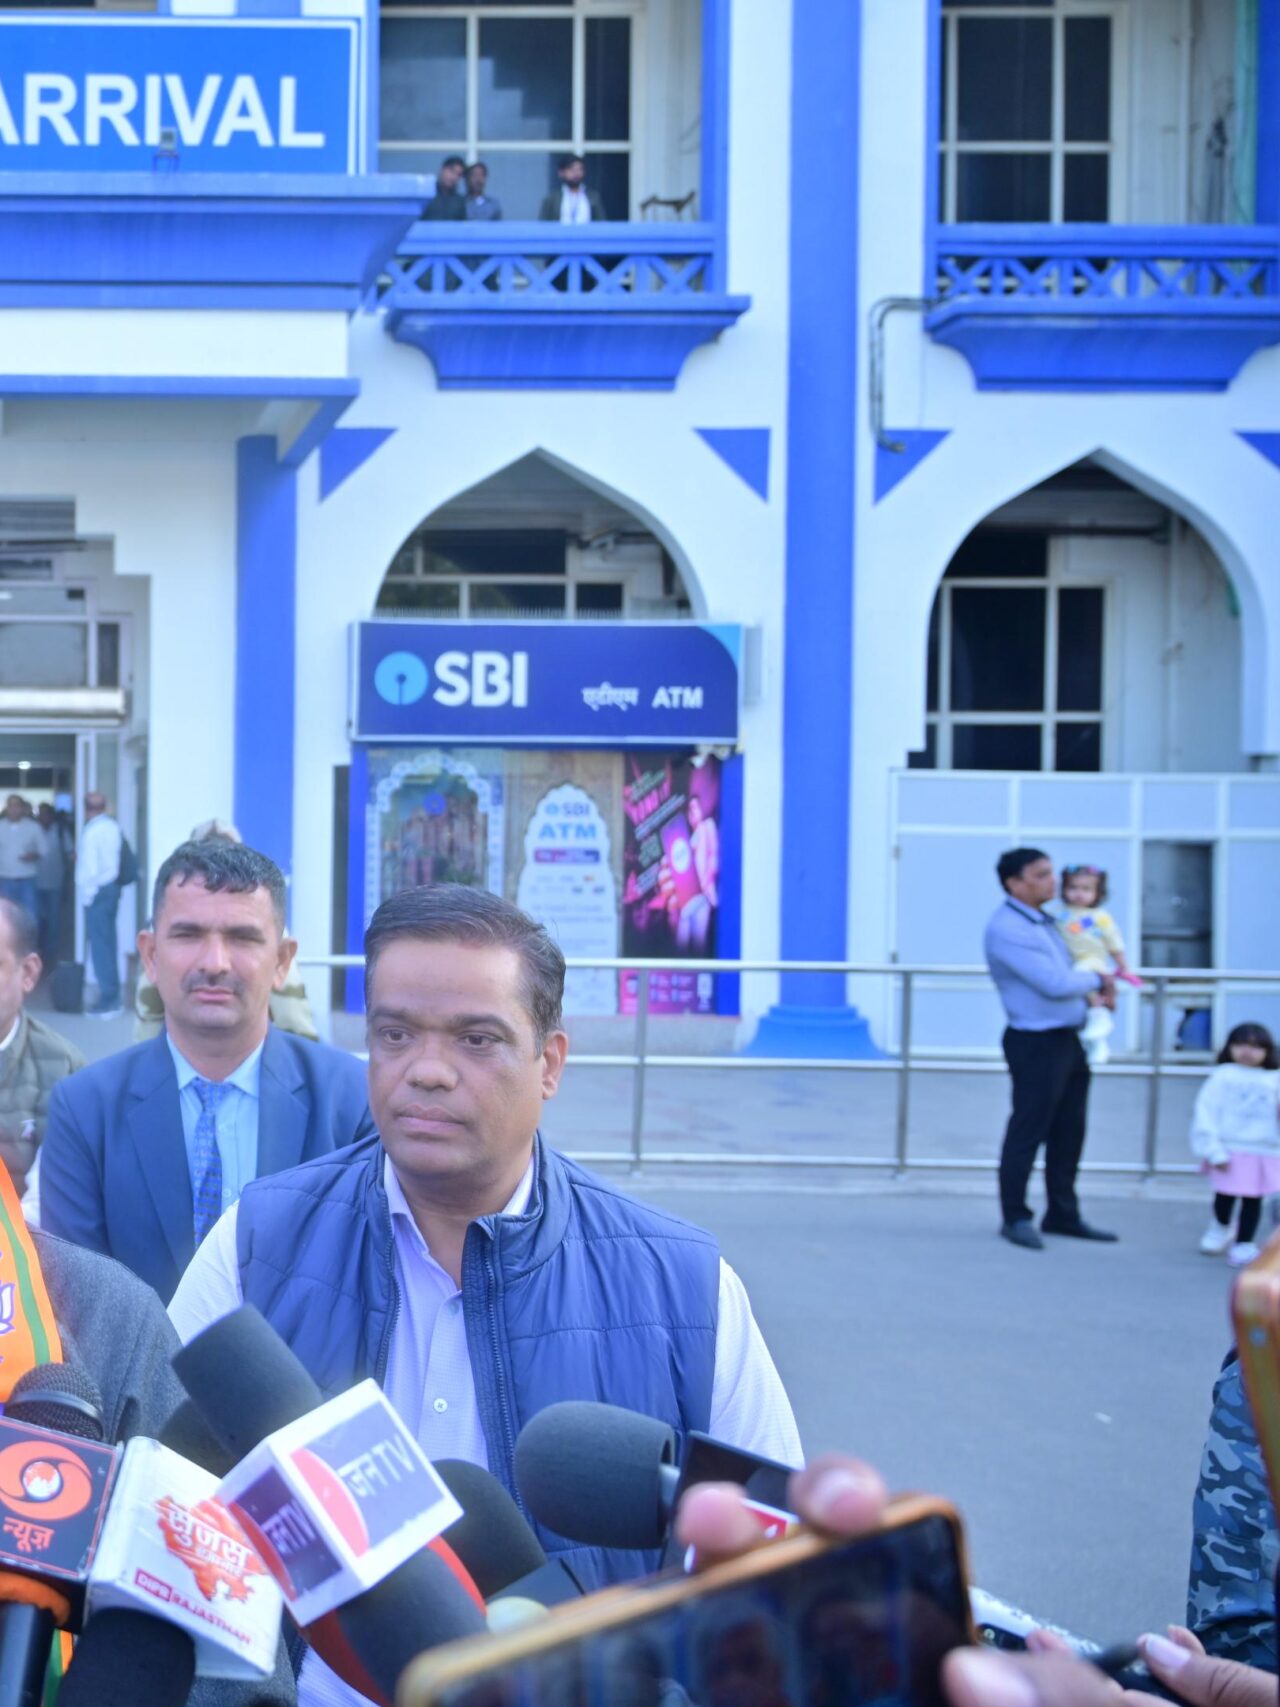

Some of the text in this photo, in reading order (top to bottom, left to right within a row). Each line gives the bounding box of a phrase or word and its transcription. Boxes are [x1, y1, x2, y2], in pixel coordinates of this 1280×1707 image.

[433, 651, 529, 708] SBI
[581, 681, 640, 712] एटीएम
[651, 686, 704, 709] ATM
[562, 802, 591, 817] SBI
[538, 823, 598, 839] ATM
